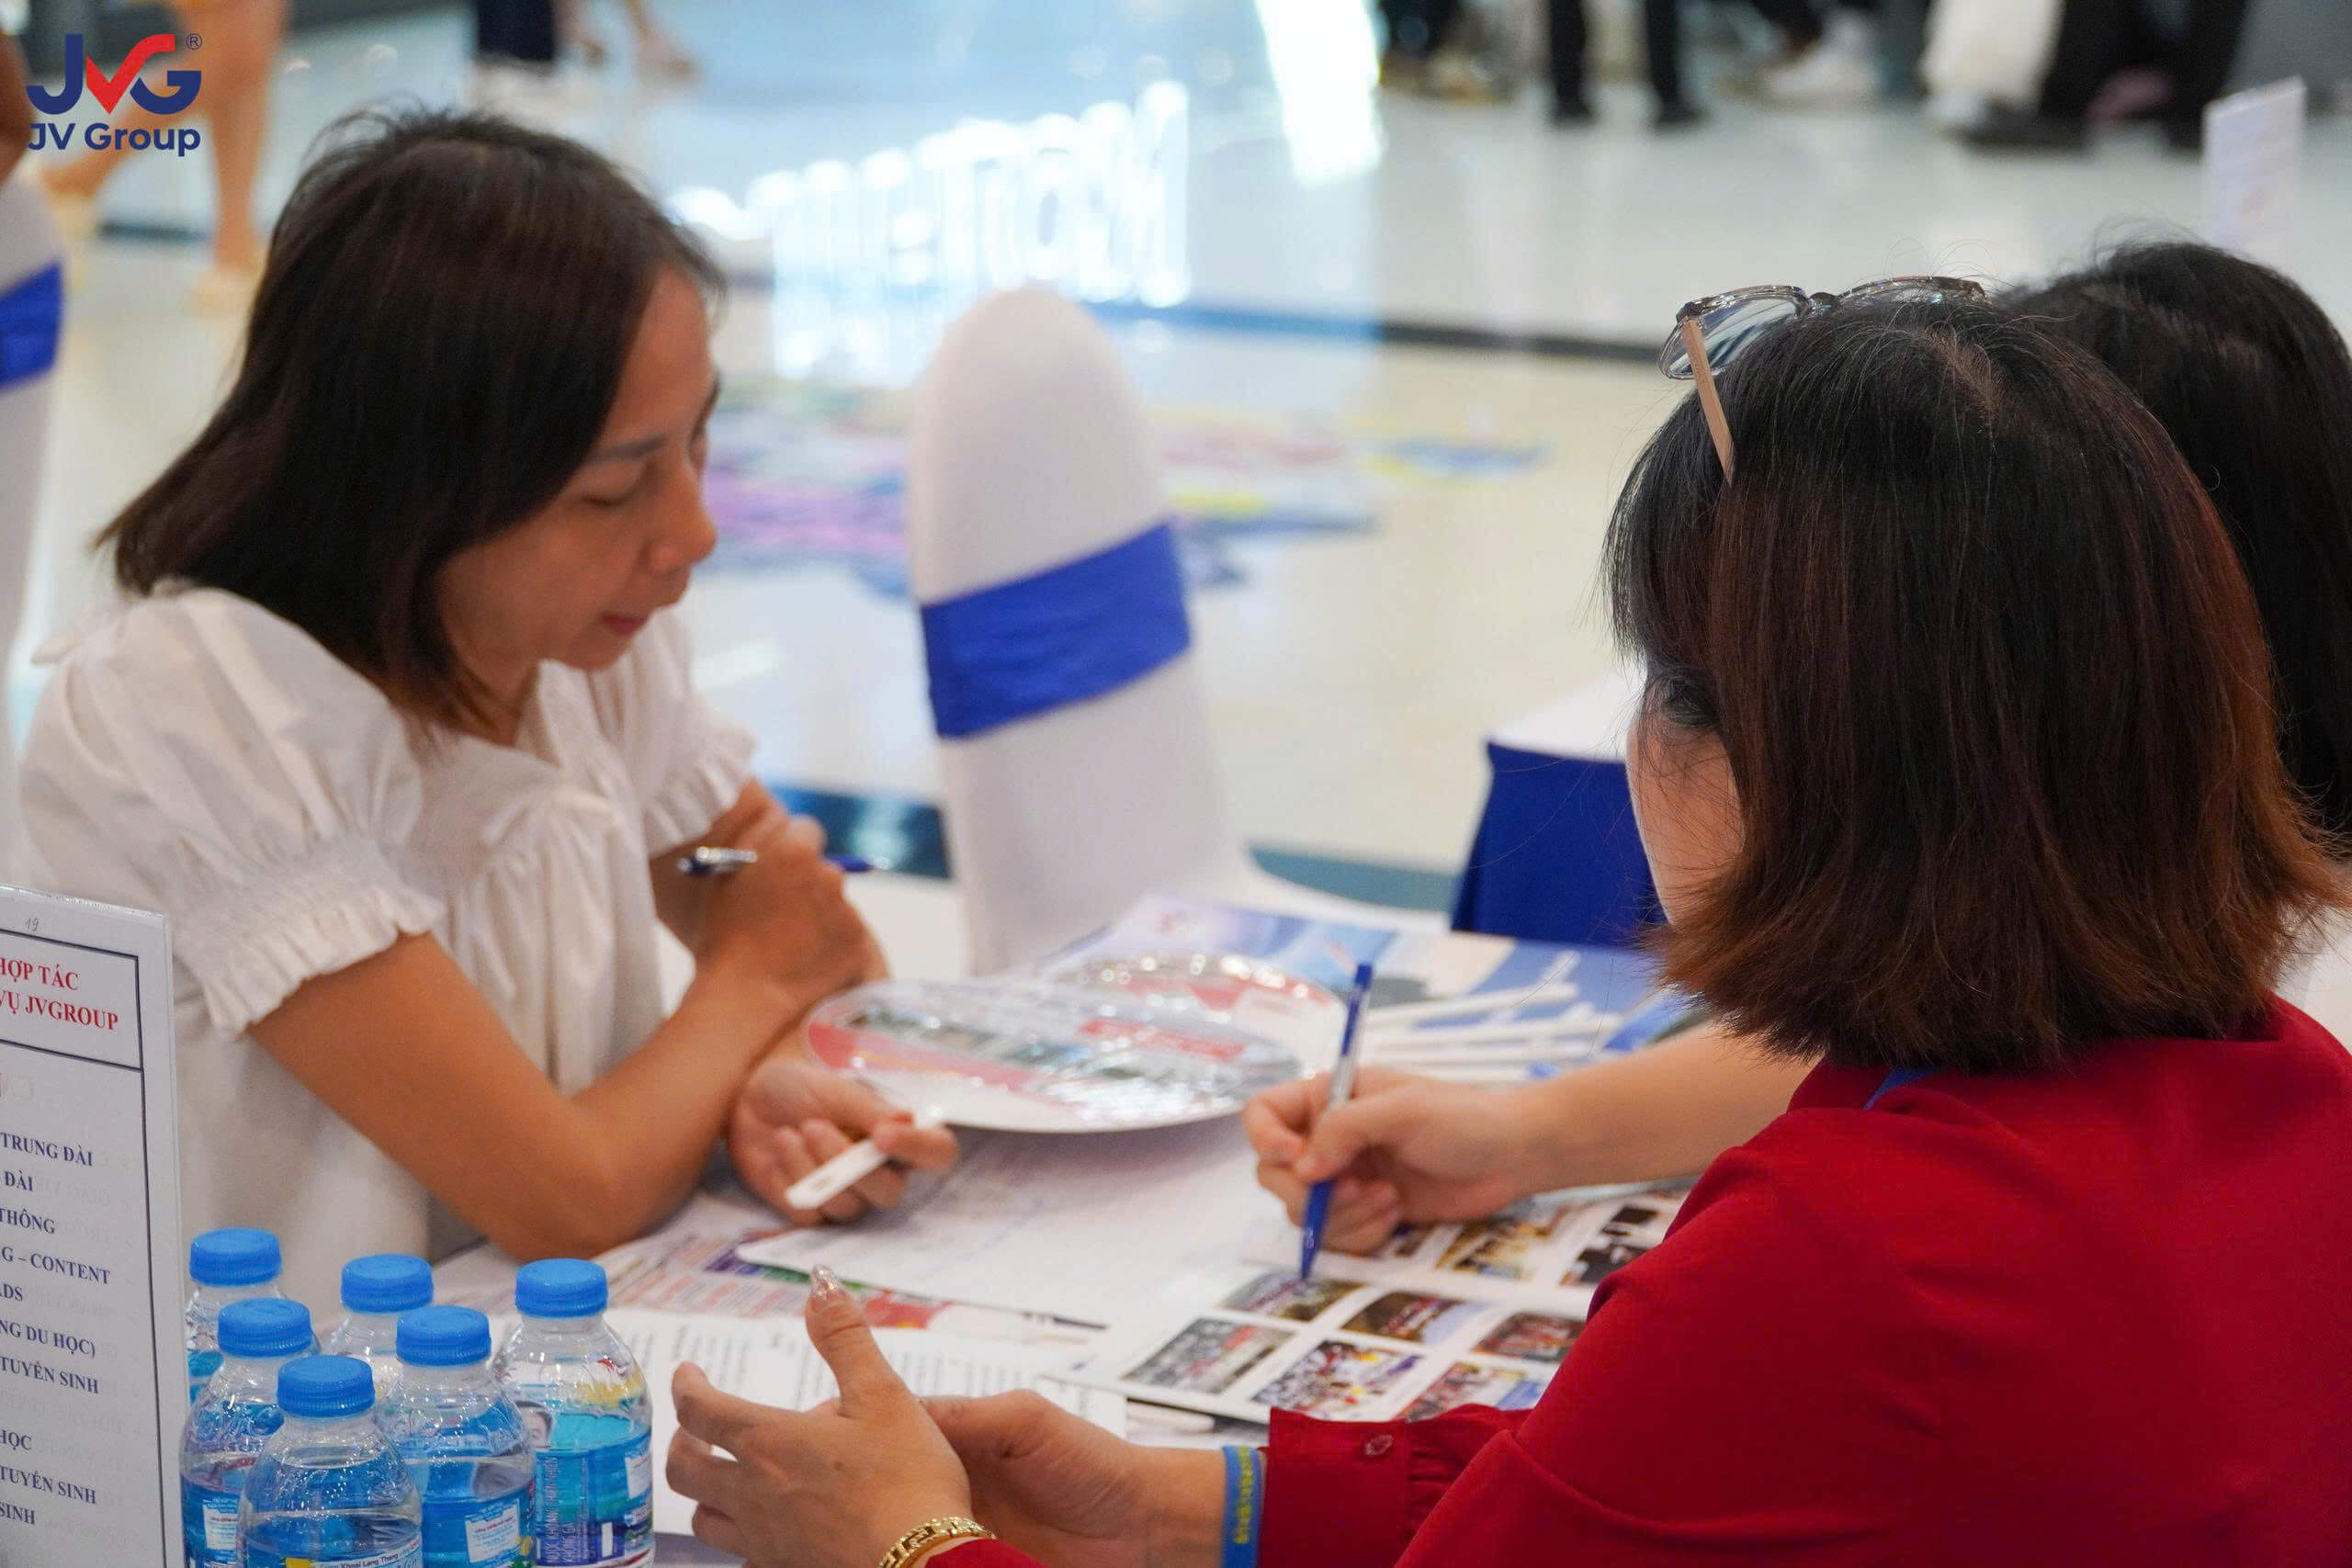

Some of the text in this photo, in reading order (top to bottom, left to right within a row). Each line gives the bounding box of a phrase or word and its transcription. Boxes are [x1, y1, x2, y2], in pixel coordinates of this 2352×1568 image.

[38, 964, 79, 990] TÁC
[25, 995, 119, 1030] JVGROUP
[0, 1132, 94, 1167] TRUNG ĐÀI
[5, 1169, 34, 1191] ĐÀI
[0, 1208, 55, 1234] THÔNG
[30, 1253, 110, 1284] CONTENT
[0, 1283, 23, 1302] DS
[26, 1325, 49, 1345] DU
[53, 1331, 96, 1358] HỌC)
[60, 1371, 99, 1394] SINH
[58, 1481, 96, 1505] SINH
